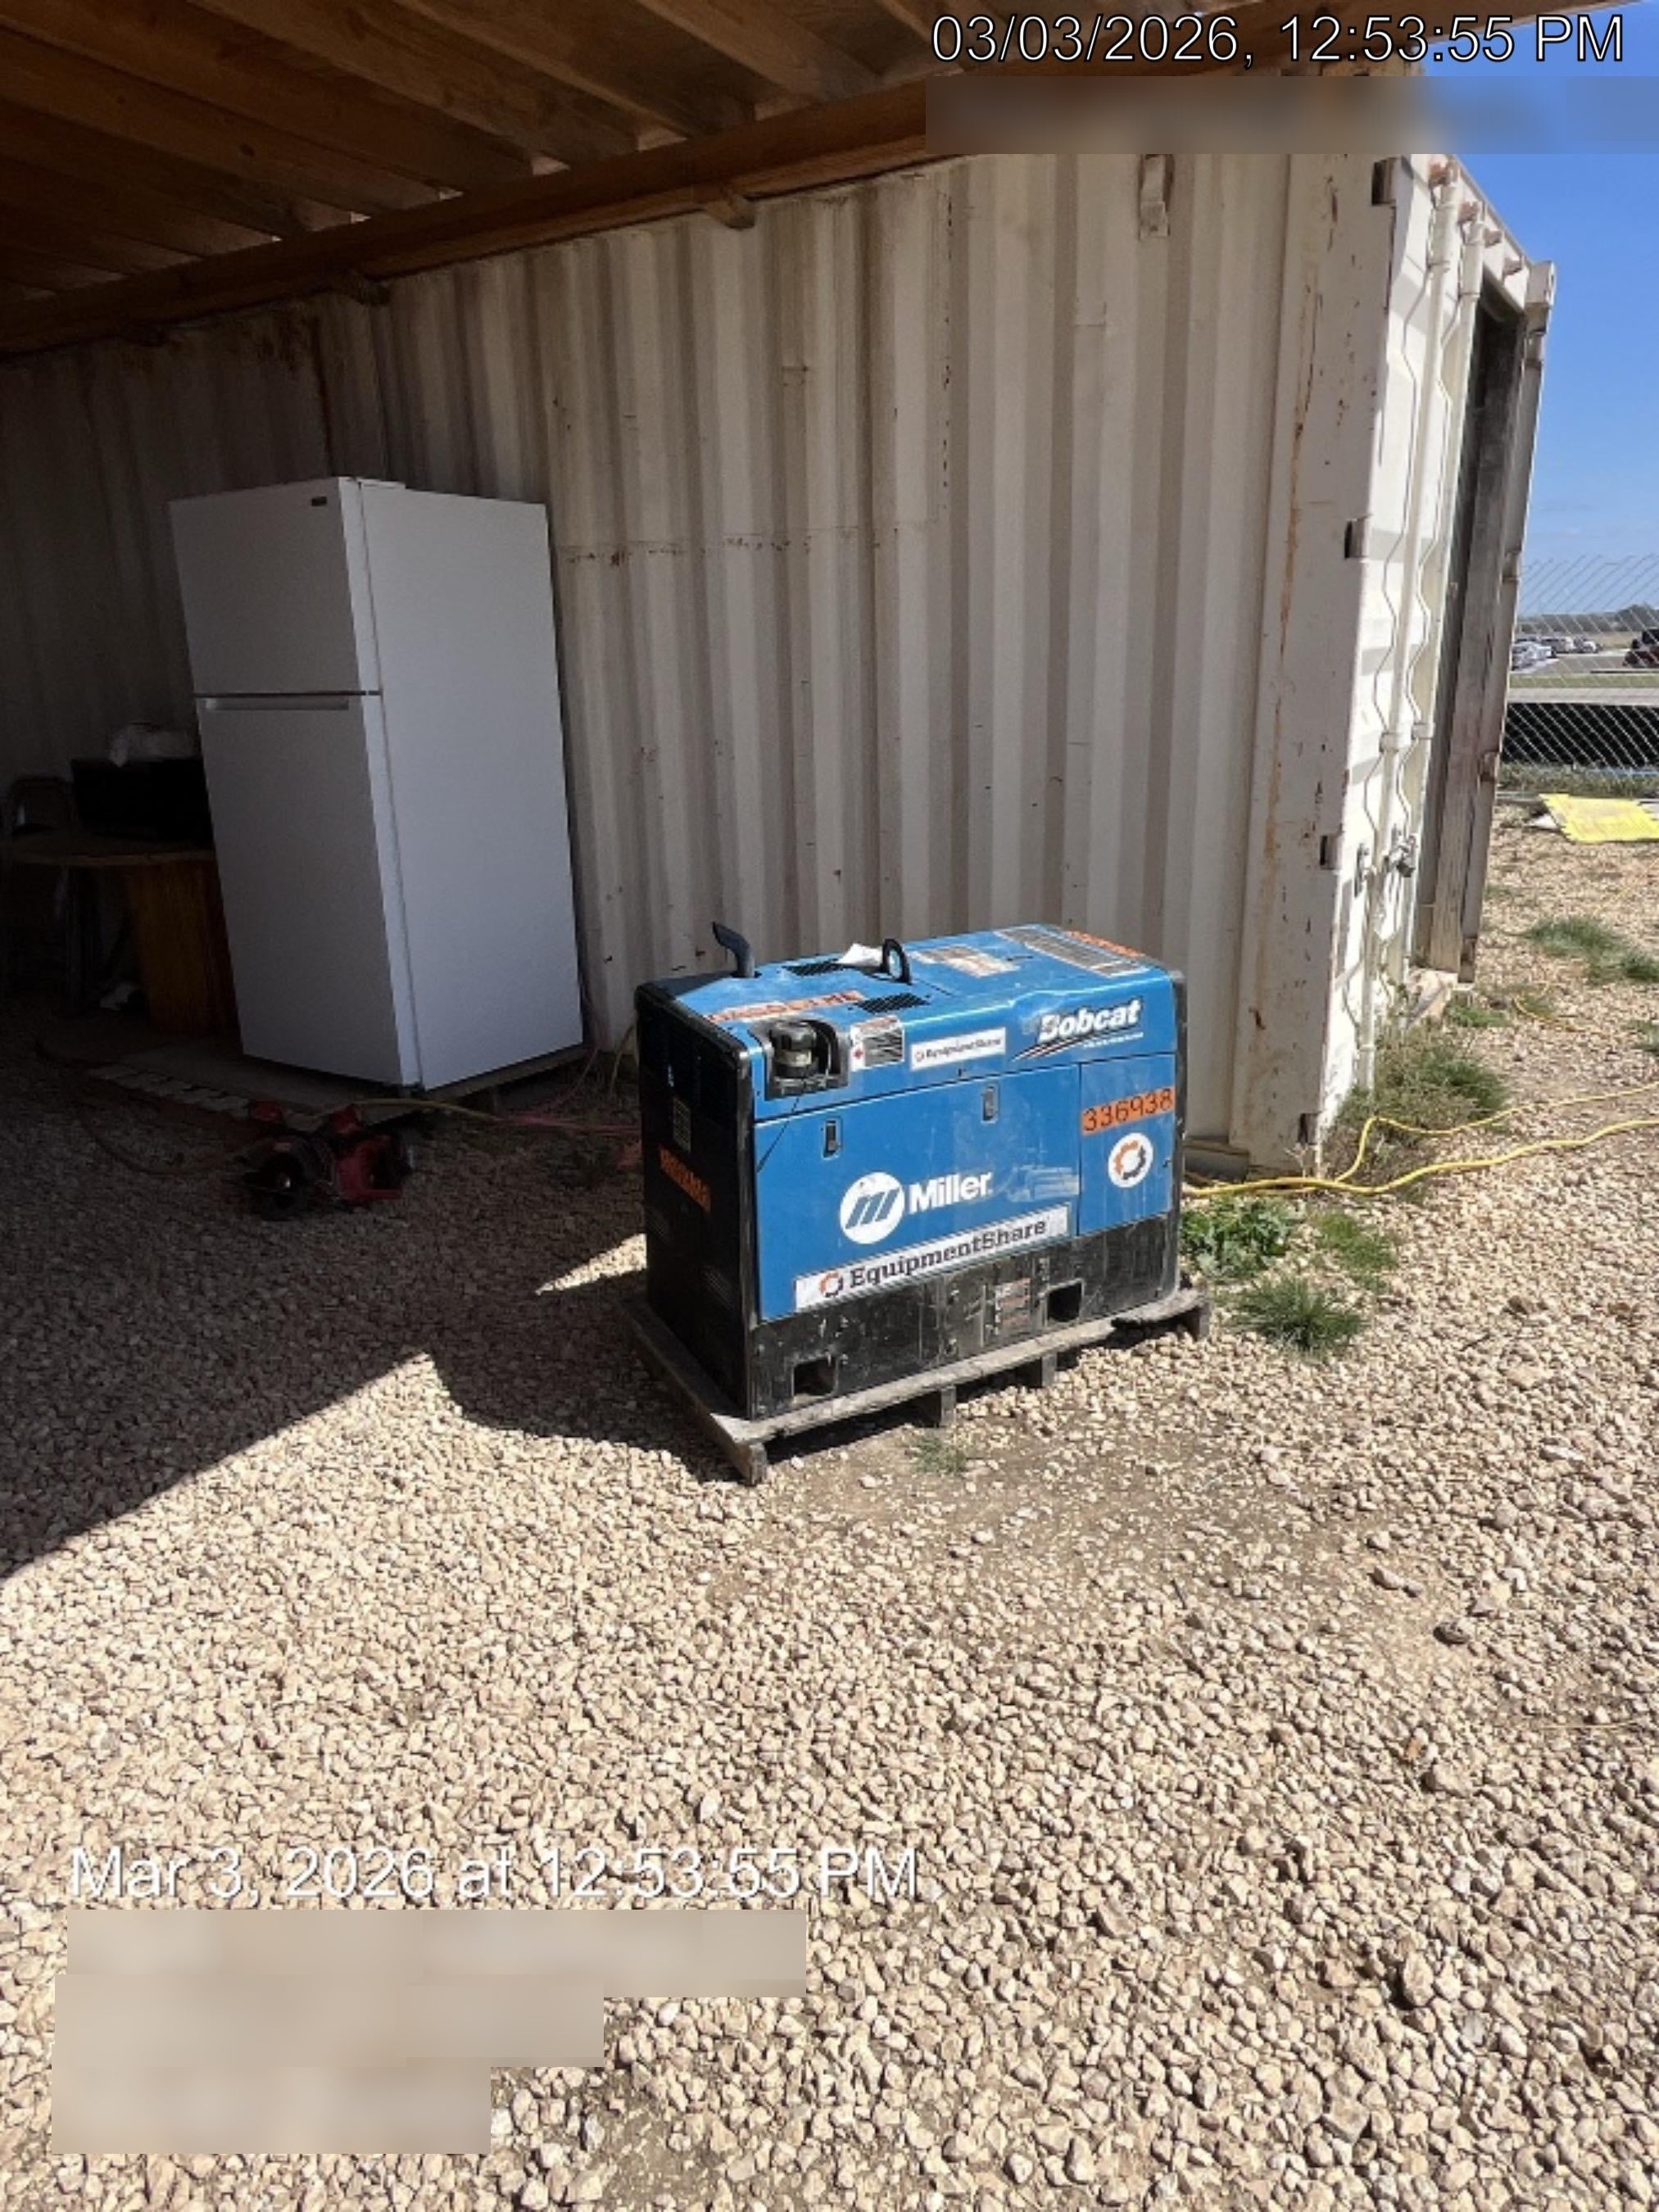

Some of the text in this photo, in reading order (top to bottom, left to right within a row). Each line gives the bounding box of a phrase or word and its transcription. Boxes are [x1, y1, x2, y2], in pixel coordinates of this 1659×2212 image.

[1038, 998, 1144, 1042] Bobcat
[1082, 1087, 1174, 1132] 336938
[908, 1172, 993, 1215] Miller
[849, 1218, 1048, 1290] EquipmentShare
